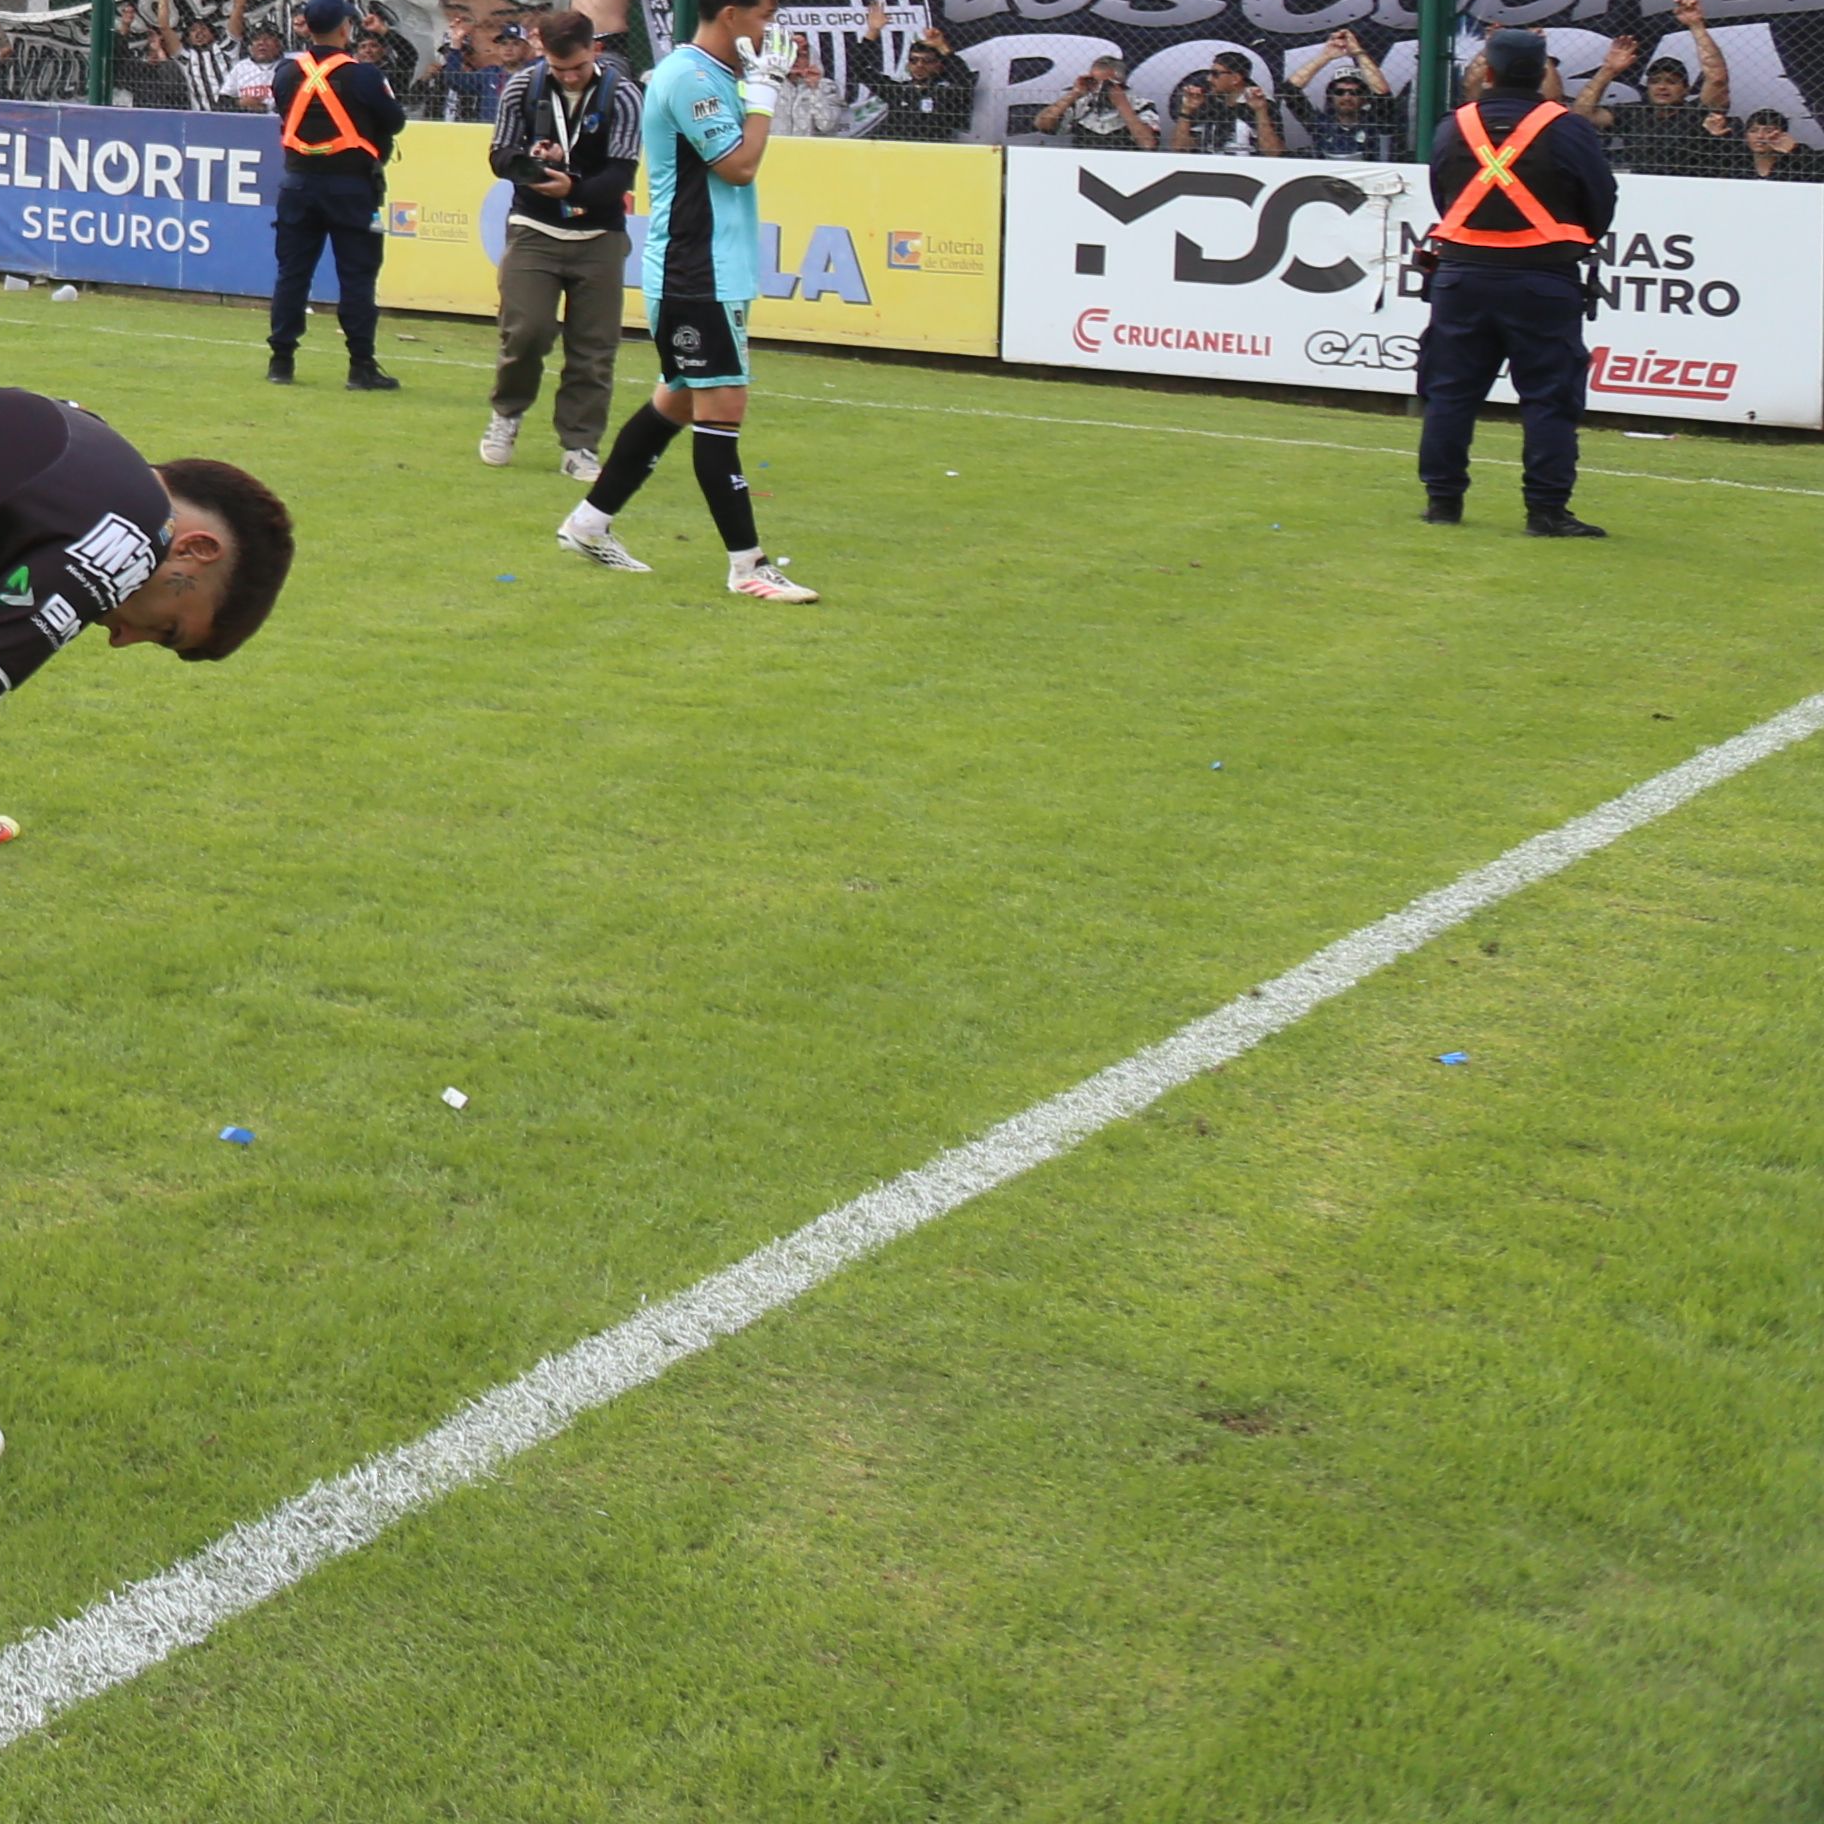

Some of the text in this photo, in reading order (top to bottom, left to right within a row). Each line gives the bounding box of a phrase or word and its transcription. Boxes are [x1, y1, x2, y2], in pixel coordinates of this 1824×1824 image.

[776, 12, 917, 25] CLUB CIPOETTI
[22, 206, 211, 255] SEGUROS
[1113, 323, 1272, 357] CRUCIANELLI
[1304, 330, 1422, 371] CAS
[1588, 346, 1738, 398] Maizco
